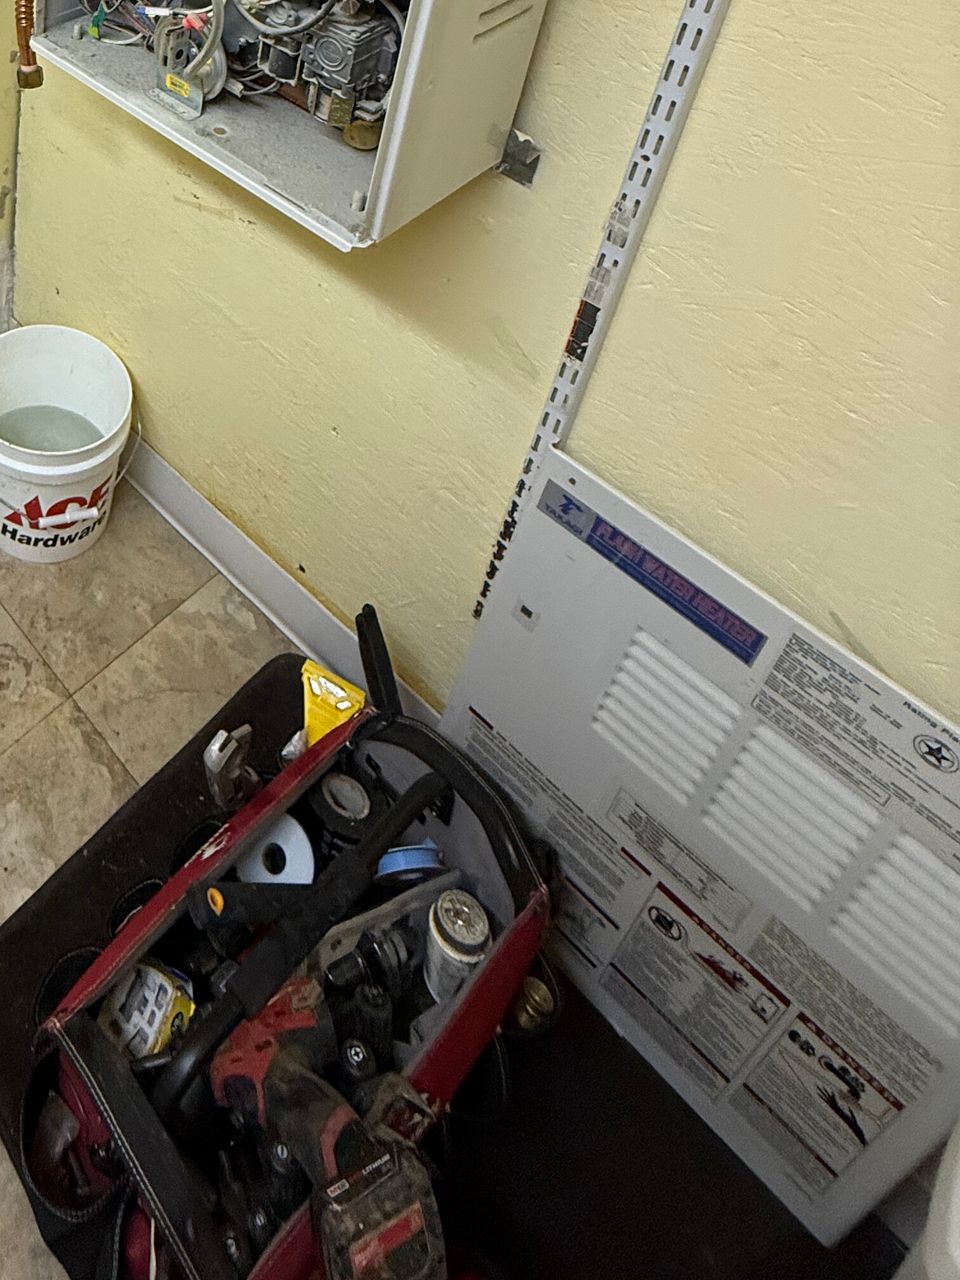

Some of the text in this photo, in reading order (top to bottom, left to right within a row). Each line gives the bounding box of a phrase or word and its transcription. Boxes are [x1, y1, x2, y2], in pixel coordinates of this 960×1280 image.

[3, 472, 114, 531] ACE
[544, 503, 583, 536] TAKAGI
[0, 510, 107, 548] Hardwar
